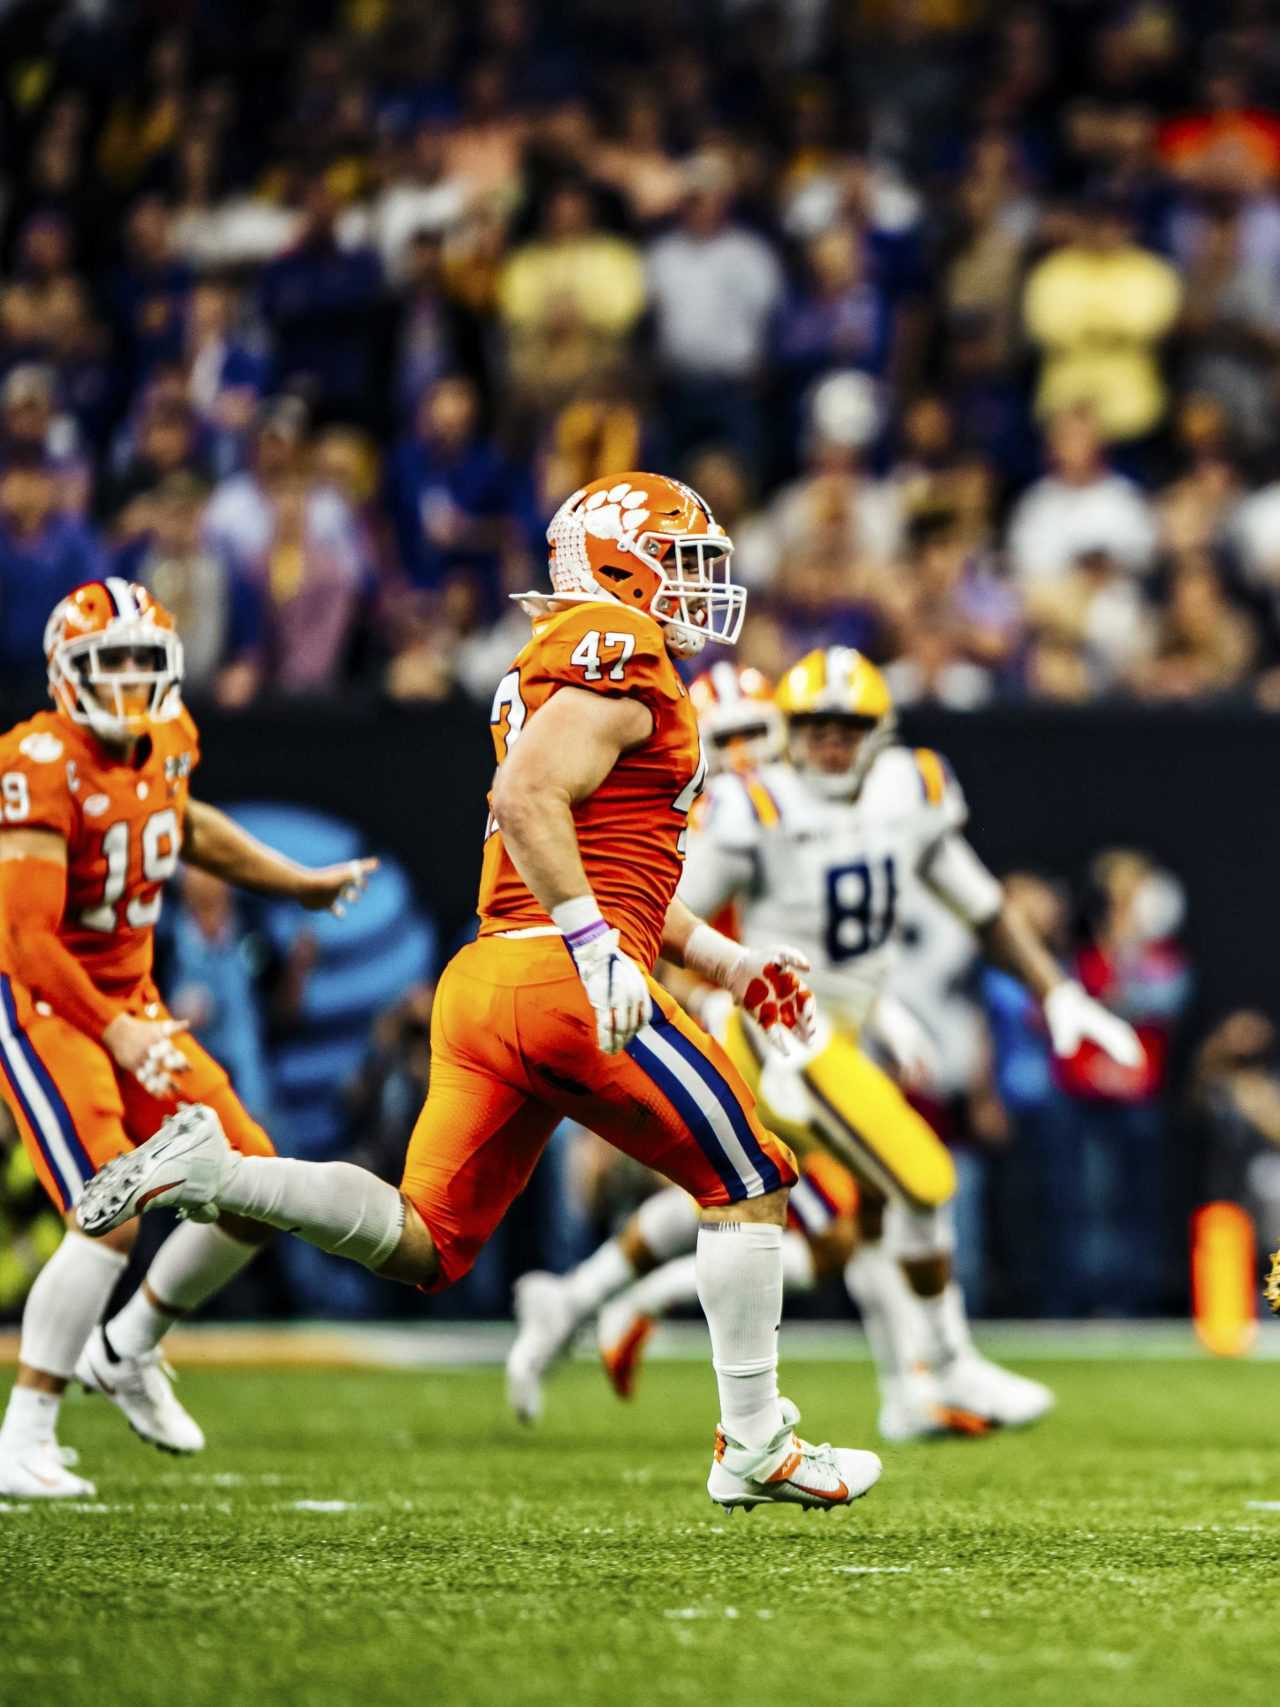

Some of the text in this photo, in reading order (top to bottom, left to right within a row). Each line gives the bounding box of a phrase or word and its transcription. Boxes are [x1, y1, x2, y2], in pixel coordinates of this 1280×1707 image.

[570, 630, 636, 681] 47
[0, 771, 31, 822] 9
[79, 807, 181, 933] 19
[825, 855, 899, 963] 81
